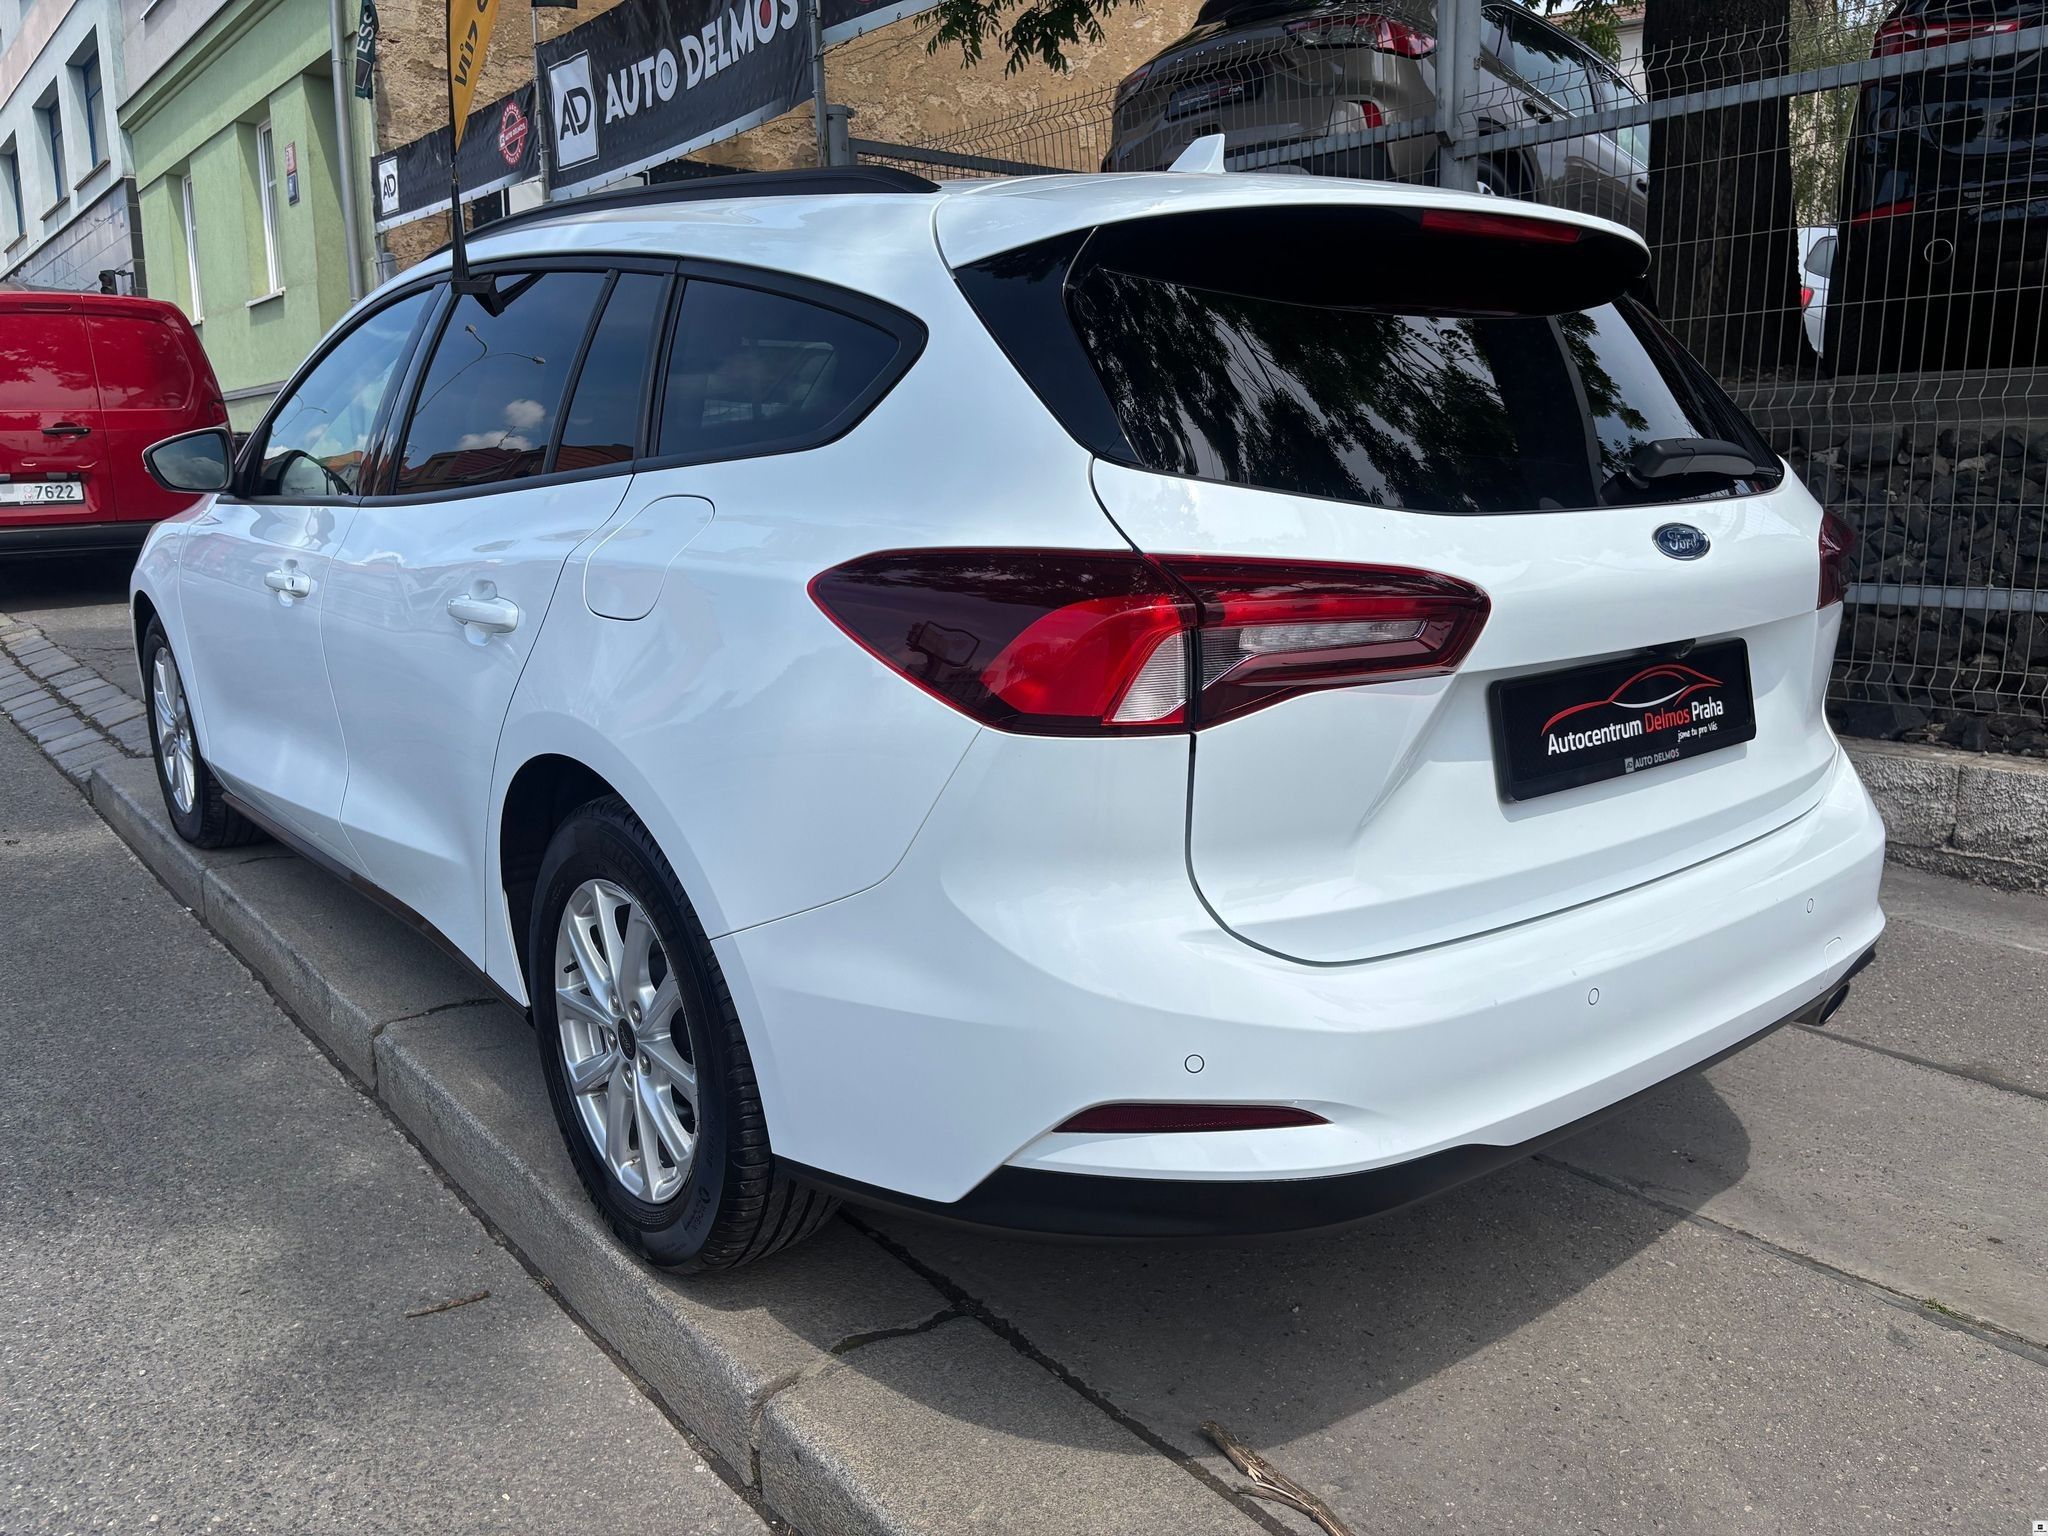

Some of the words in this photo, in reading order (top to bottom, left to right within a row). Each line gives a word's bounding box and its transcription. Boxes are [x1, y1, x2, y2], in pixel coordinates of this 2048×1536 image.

[559, 86, 592, 141] AD
[605, 48, 679, 125] AUTO
[680, 0, 799, 90] DELMOS
[34, 484, 75, 500] 7622
[1667, 530, 1700, 551] Ford
[1547, 719, 1643, 756] Autocentrum
[1644, 708, 1691, 734] Delmos
[1691, 696, 1724, 722] Praha
[1698, 725, 1708, 739] pro
[1634, 755, 1653, 769] AUTO
[1653, 748, 1680, 764] DELMOS
